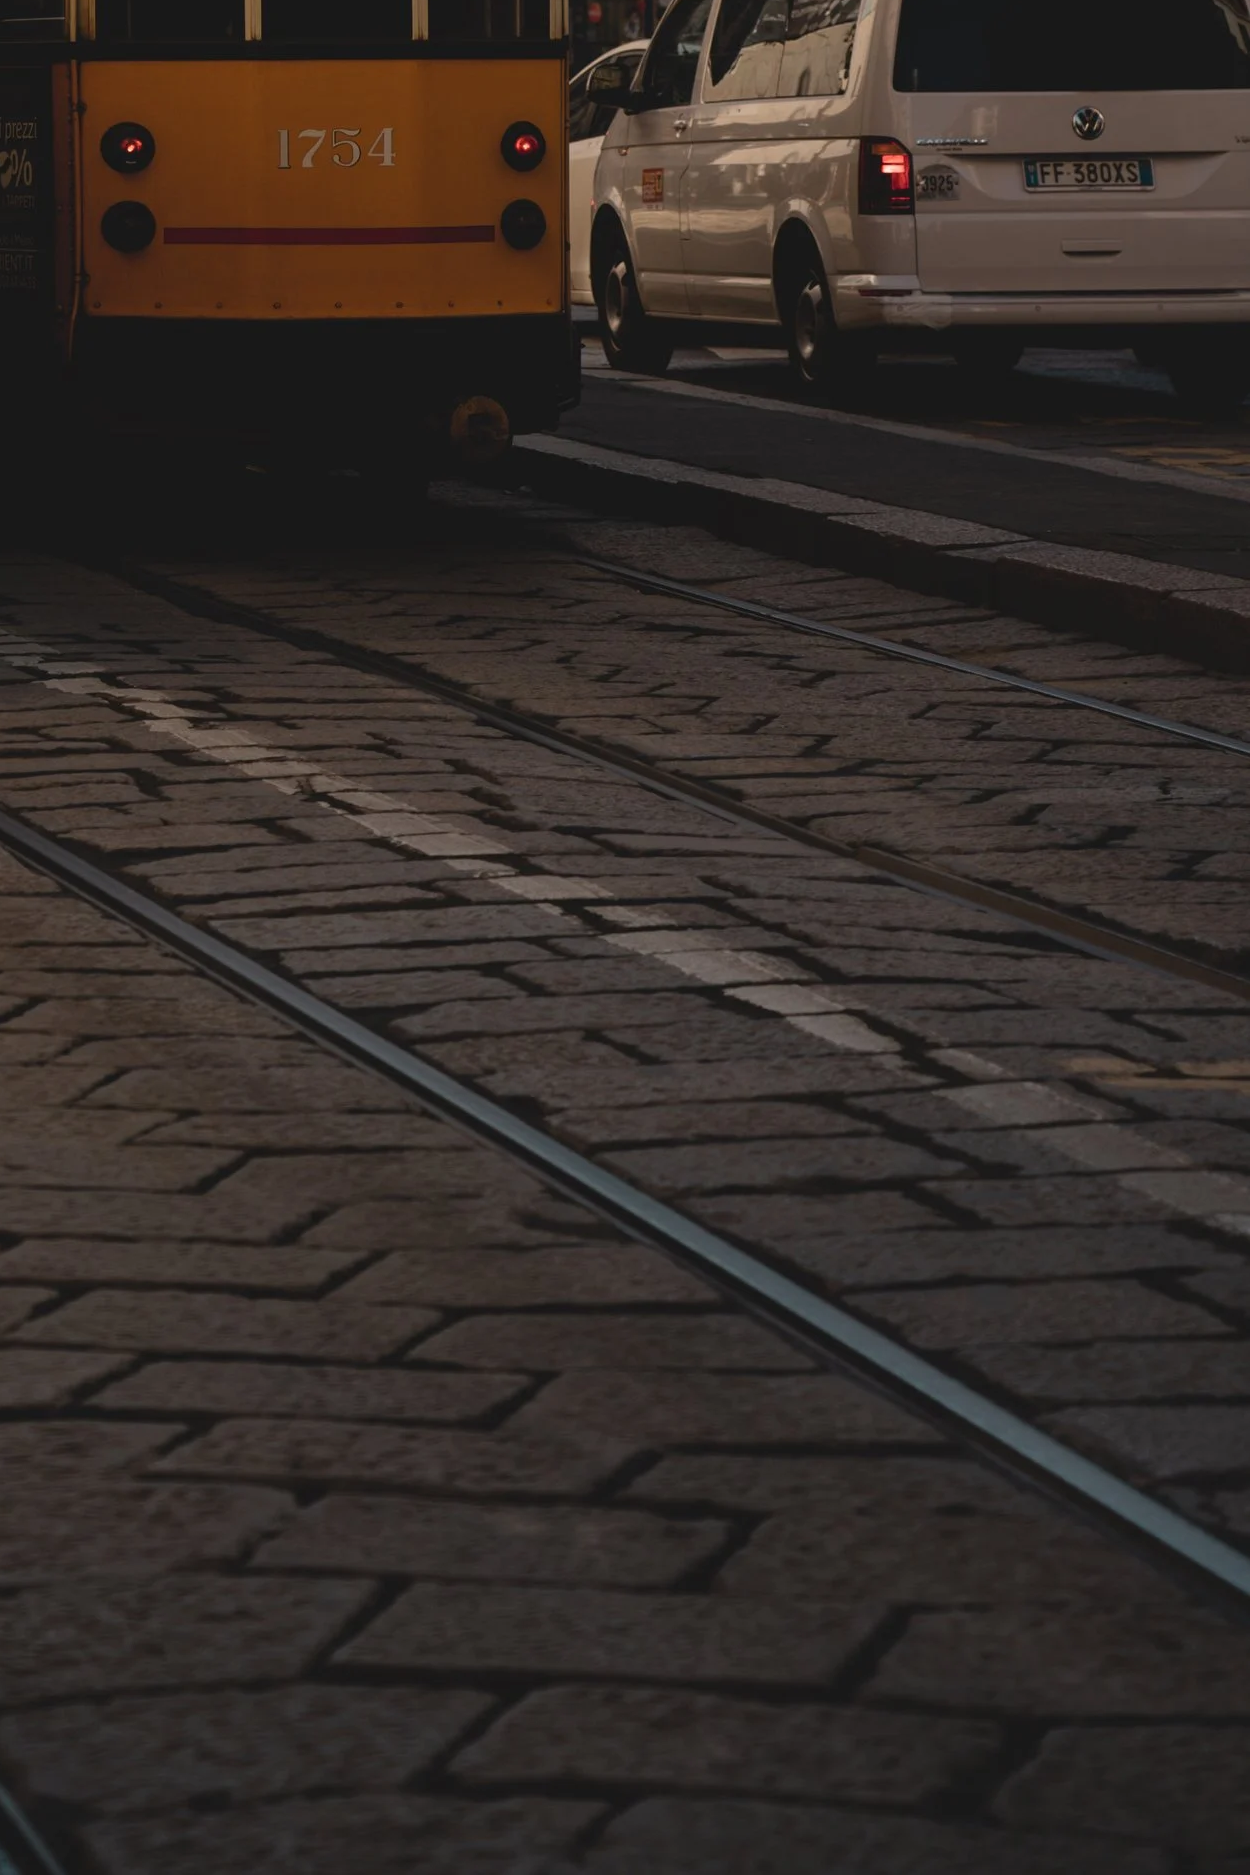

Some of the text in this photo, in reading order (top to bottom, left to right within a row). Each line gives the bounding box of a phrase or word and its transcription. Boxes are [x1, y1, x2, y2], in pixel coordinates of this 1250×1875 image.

[4, 116, 38, 145] prezzi
[277, 126, 397, 170] 1754
[921, 174, 954, 192] 3925
